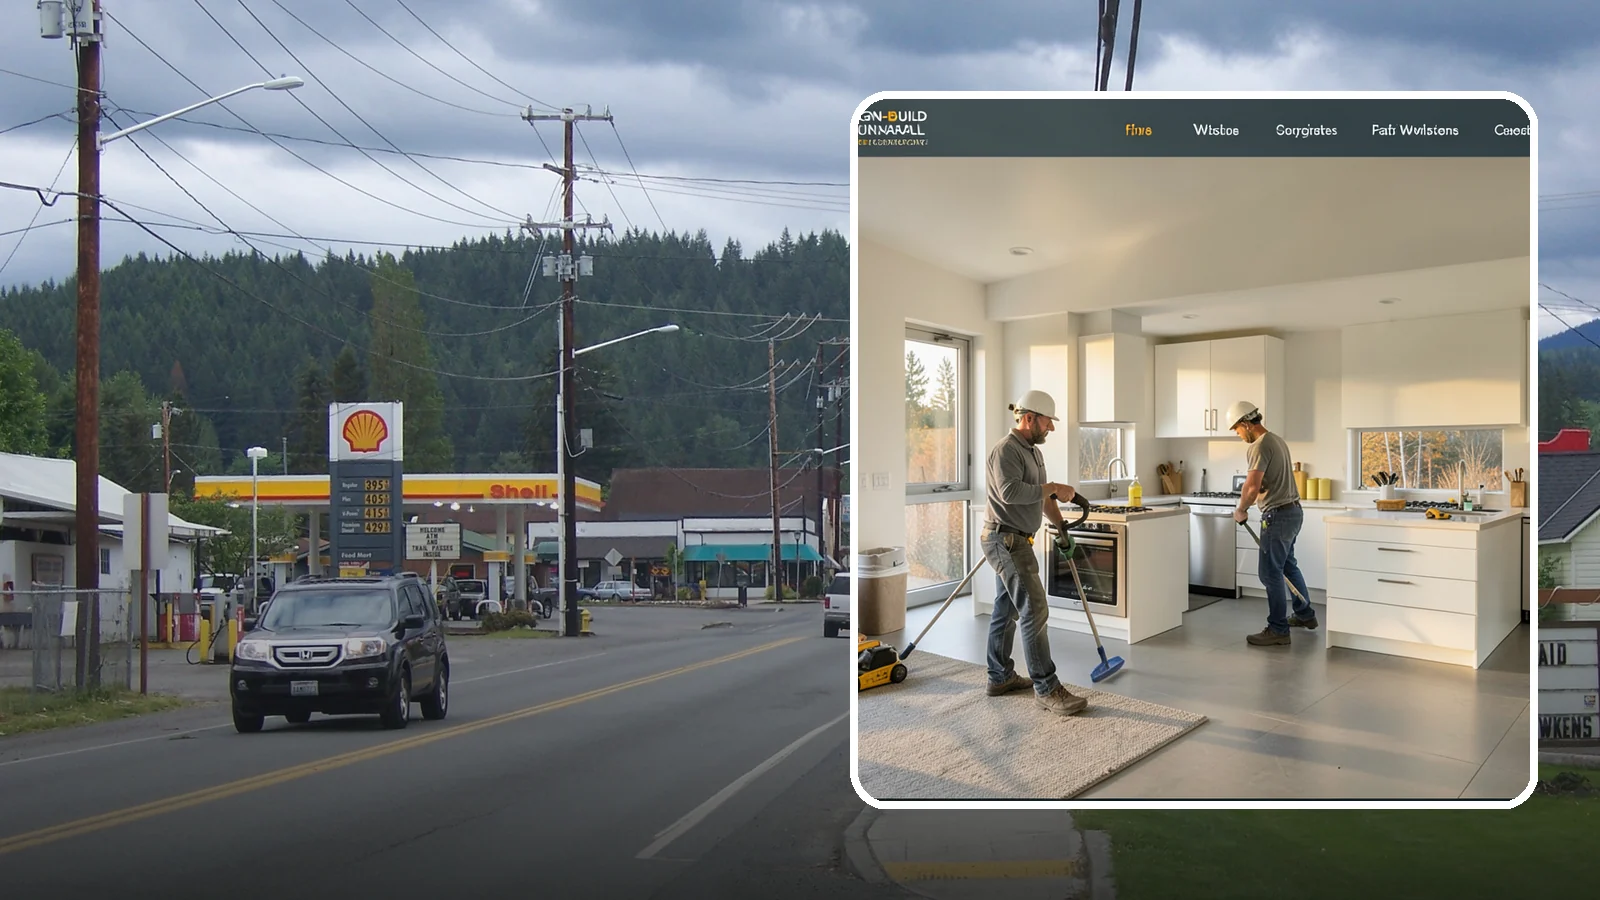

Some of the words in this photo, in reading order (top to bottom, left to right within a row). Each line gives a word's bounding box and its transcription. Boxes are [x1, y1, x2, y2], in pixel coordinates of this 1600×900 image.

[365, 480, 383, 490] 395
[490, 484, 547, 499] Shell
[365, 494, 383, 504] 405
[365, 508, 383, 518] 415
[366, 522, 383, 532] 429
